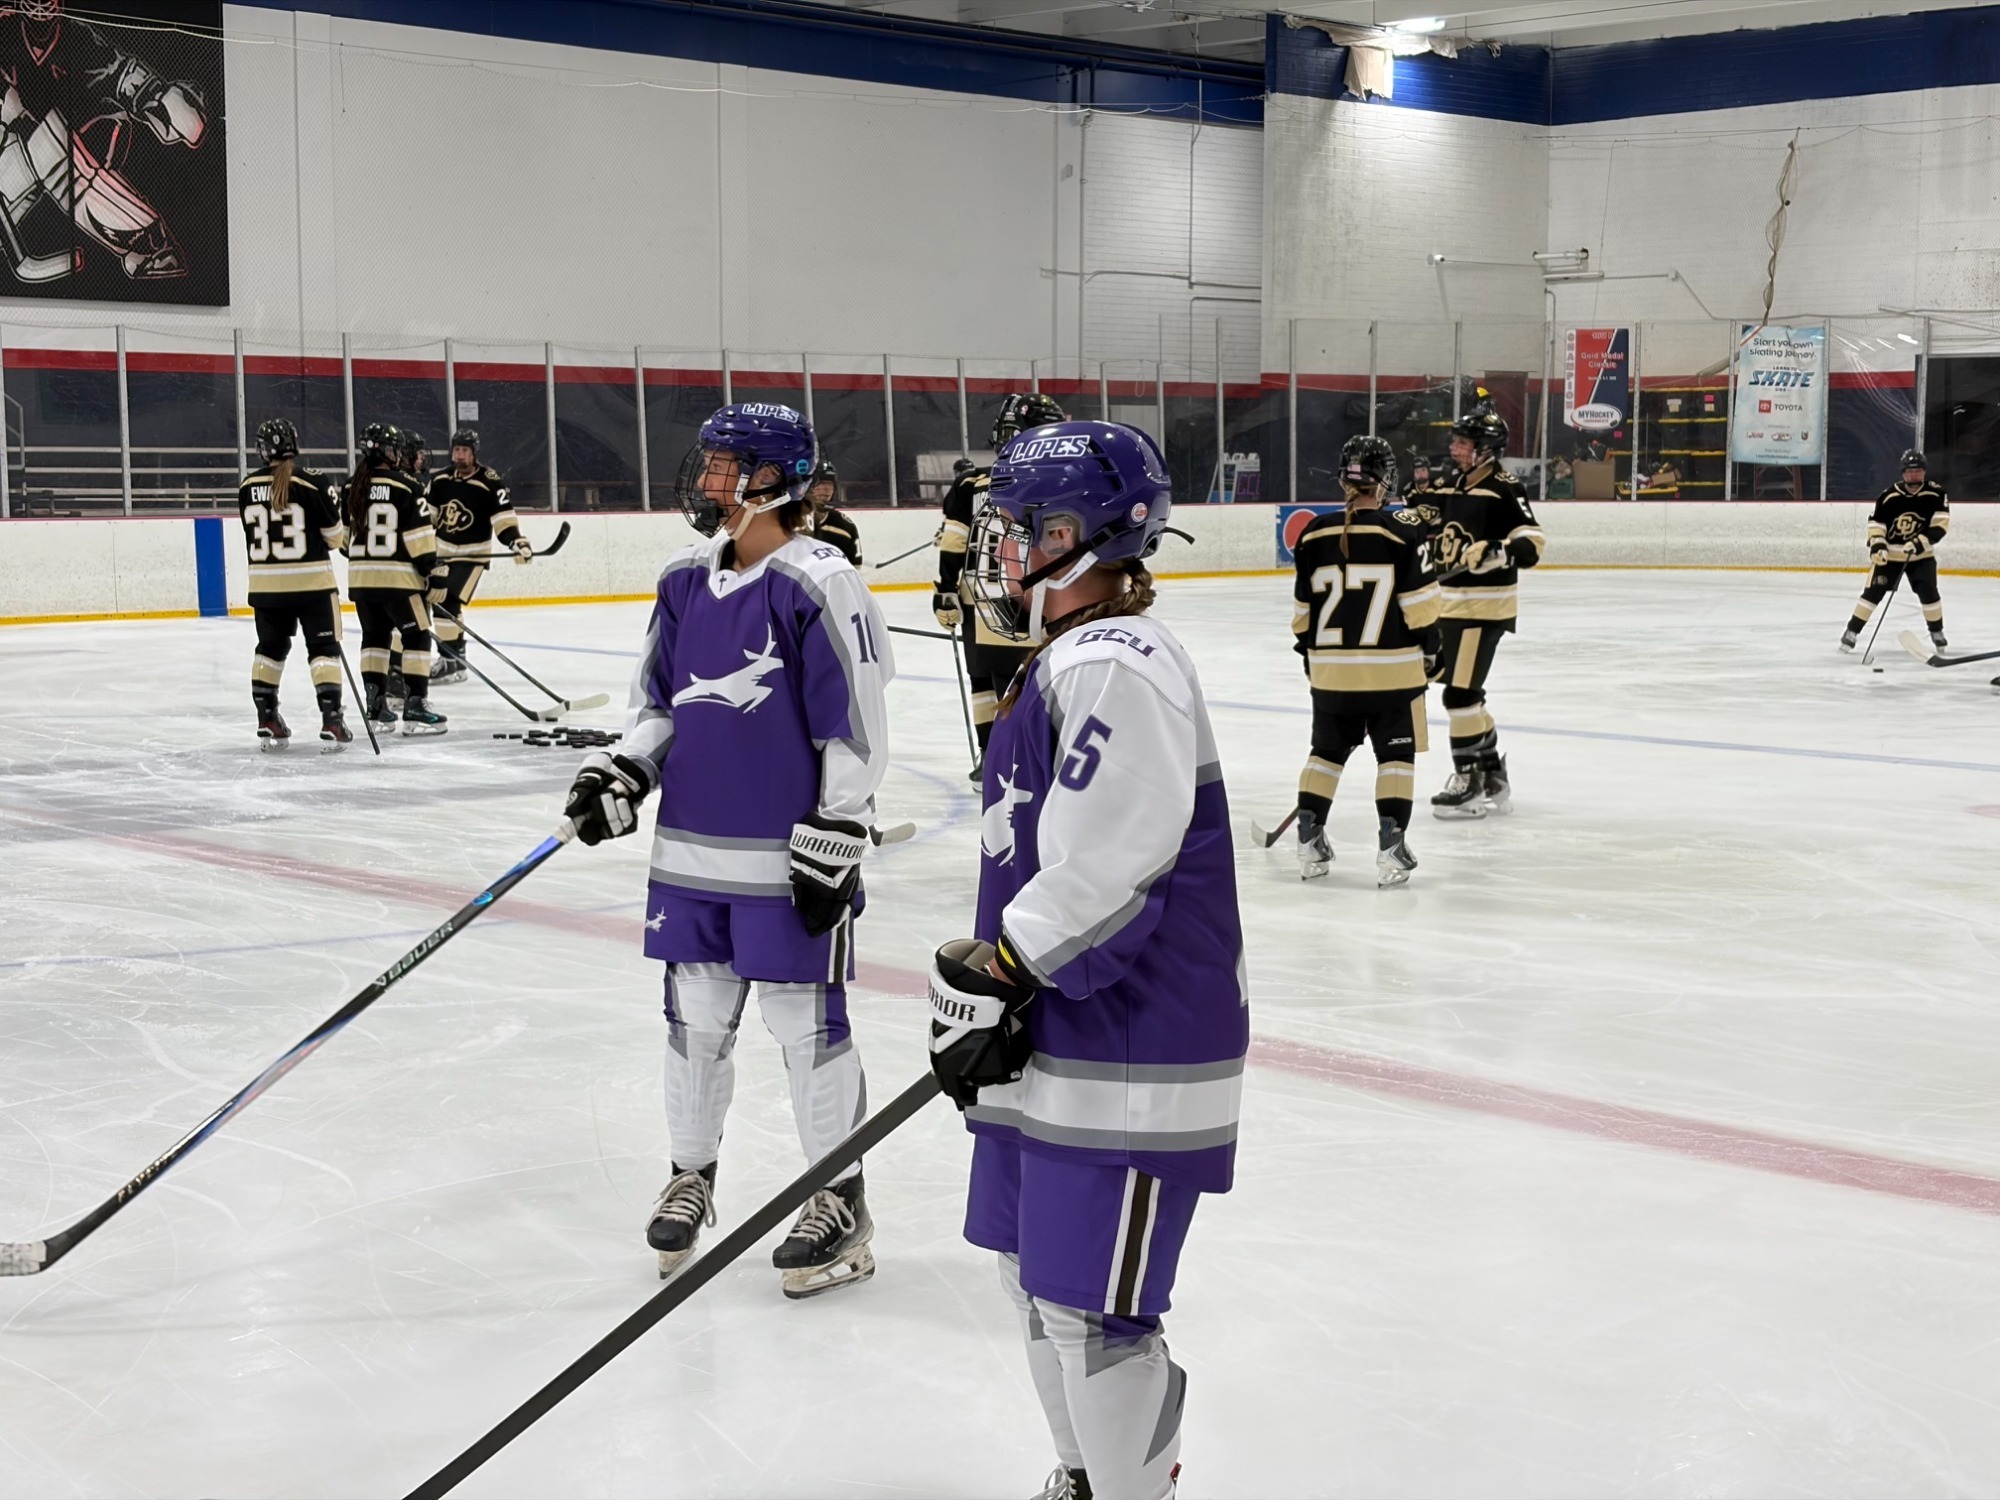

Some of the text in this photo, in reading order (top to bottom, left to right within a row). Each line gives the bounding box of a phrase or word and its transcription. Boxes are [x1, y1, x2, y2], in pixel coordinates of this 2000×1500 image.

[1753, 338, 1776, 346] Start
[1793, 341, 1814, 349] own
[1581, 352, 1599, 360] Gold
[1749, 348, 1783, 358] skating
[1748, 370, 1815, 388] SKATE
[741, 403, 799, 424] LOPES
[1774, 403, 1803, 412] TOYOTA
[1010, 435, 1090, 464] LOPES
[251, 485, 271, 503] EW
[370, 485, 391, 501] SON
[244, 502, 307, 561] 33
[1006, 533, 1030, 544] CCM
[811, 547, 847, 561] GC
[1310, 563, 1395, 647] 27
[1075, 628, 1157, 658] GCU
[1058, 713, 1113, 792] 5
[928, 986, 976, 1022] RIOR
